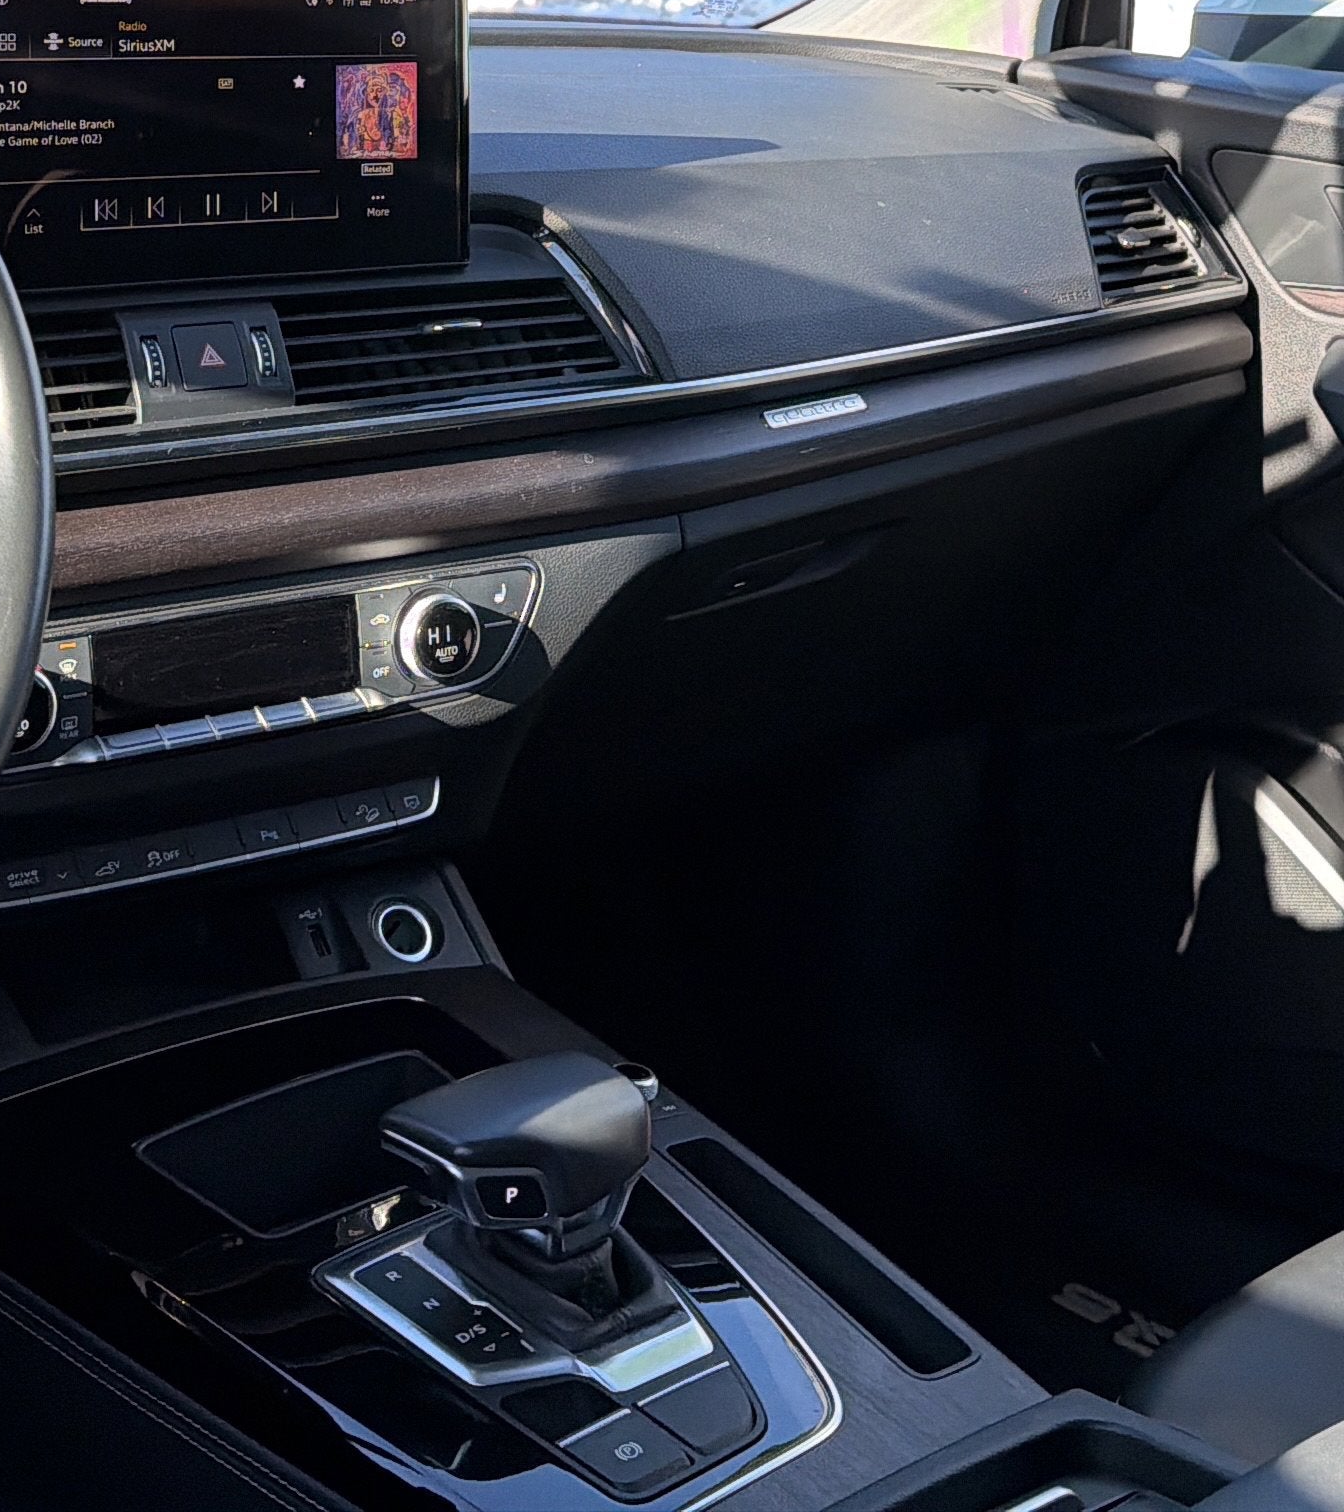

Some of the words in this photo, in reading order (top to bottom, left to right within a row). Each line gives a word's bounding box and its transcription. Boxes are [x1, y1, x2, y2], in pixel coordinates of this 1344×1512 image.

[118, 20, 147, 32] Radio
[67, 36, 103, 49] Source
[118, 38, 175, 53] SiriusXM
[9, 80, 28, 95] 10
[79, 118, 115, 130] Branch
[8, 135, 39, 147] Game
[41, 134, 53, 146] of
[55, 134, 78, 146] Love
[81, 133, 103, 146] (02)
[364, 165, 391, 174] Related
[366, 206, 390, 218] More
[24, 223, 44, 235] List
[771, 398, 857, 424] quattro
[435, 645, 459, 658] AUTO
[372, 666, 391, 679] OFF
[162, 848, 181, 862] OFF
[6, 869, 38, 881] drive
[8, 876, 41, 889] select
[505, 1186, 519, 1204] P
[384, 1270, 403, 1282] R
[454, 1323, 488, 1345] D/S
